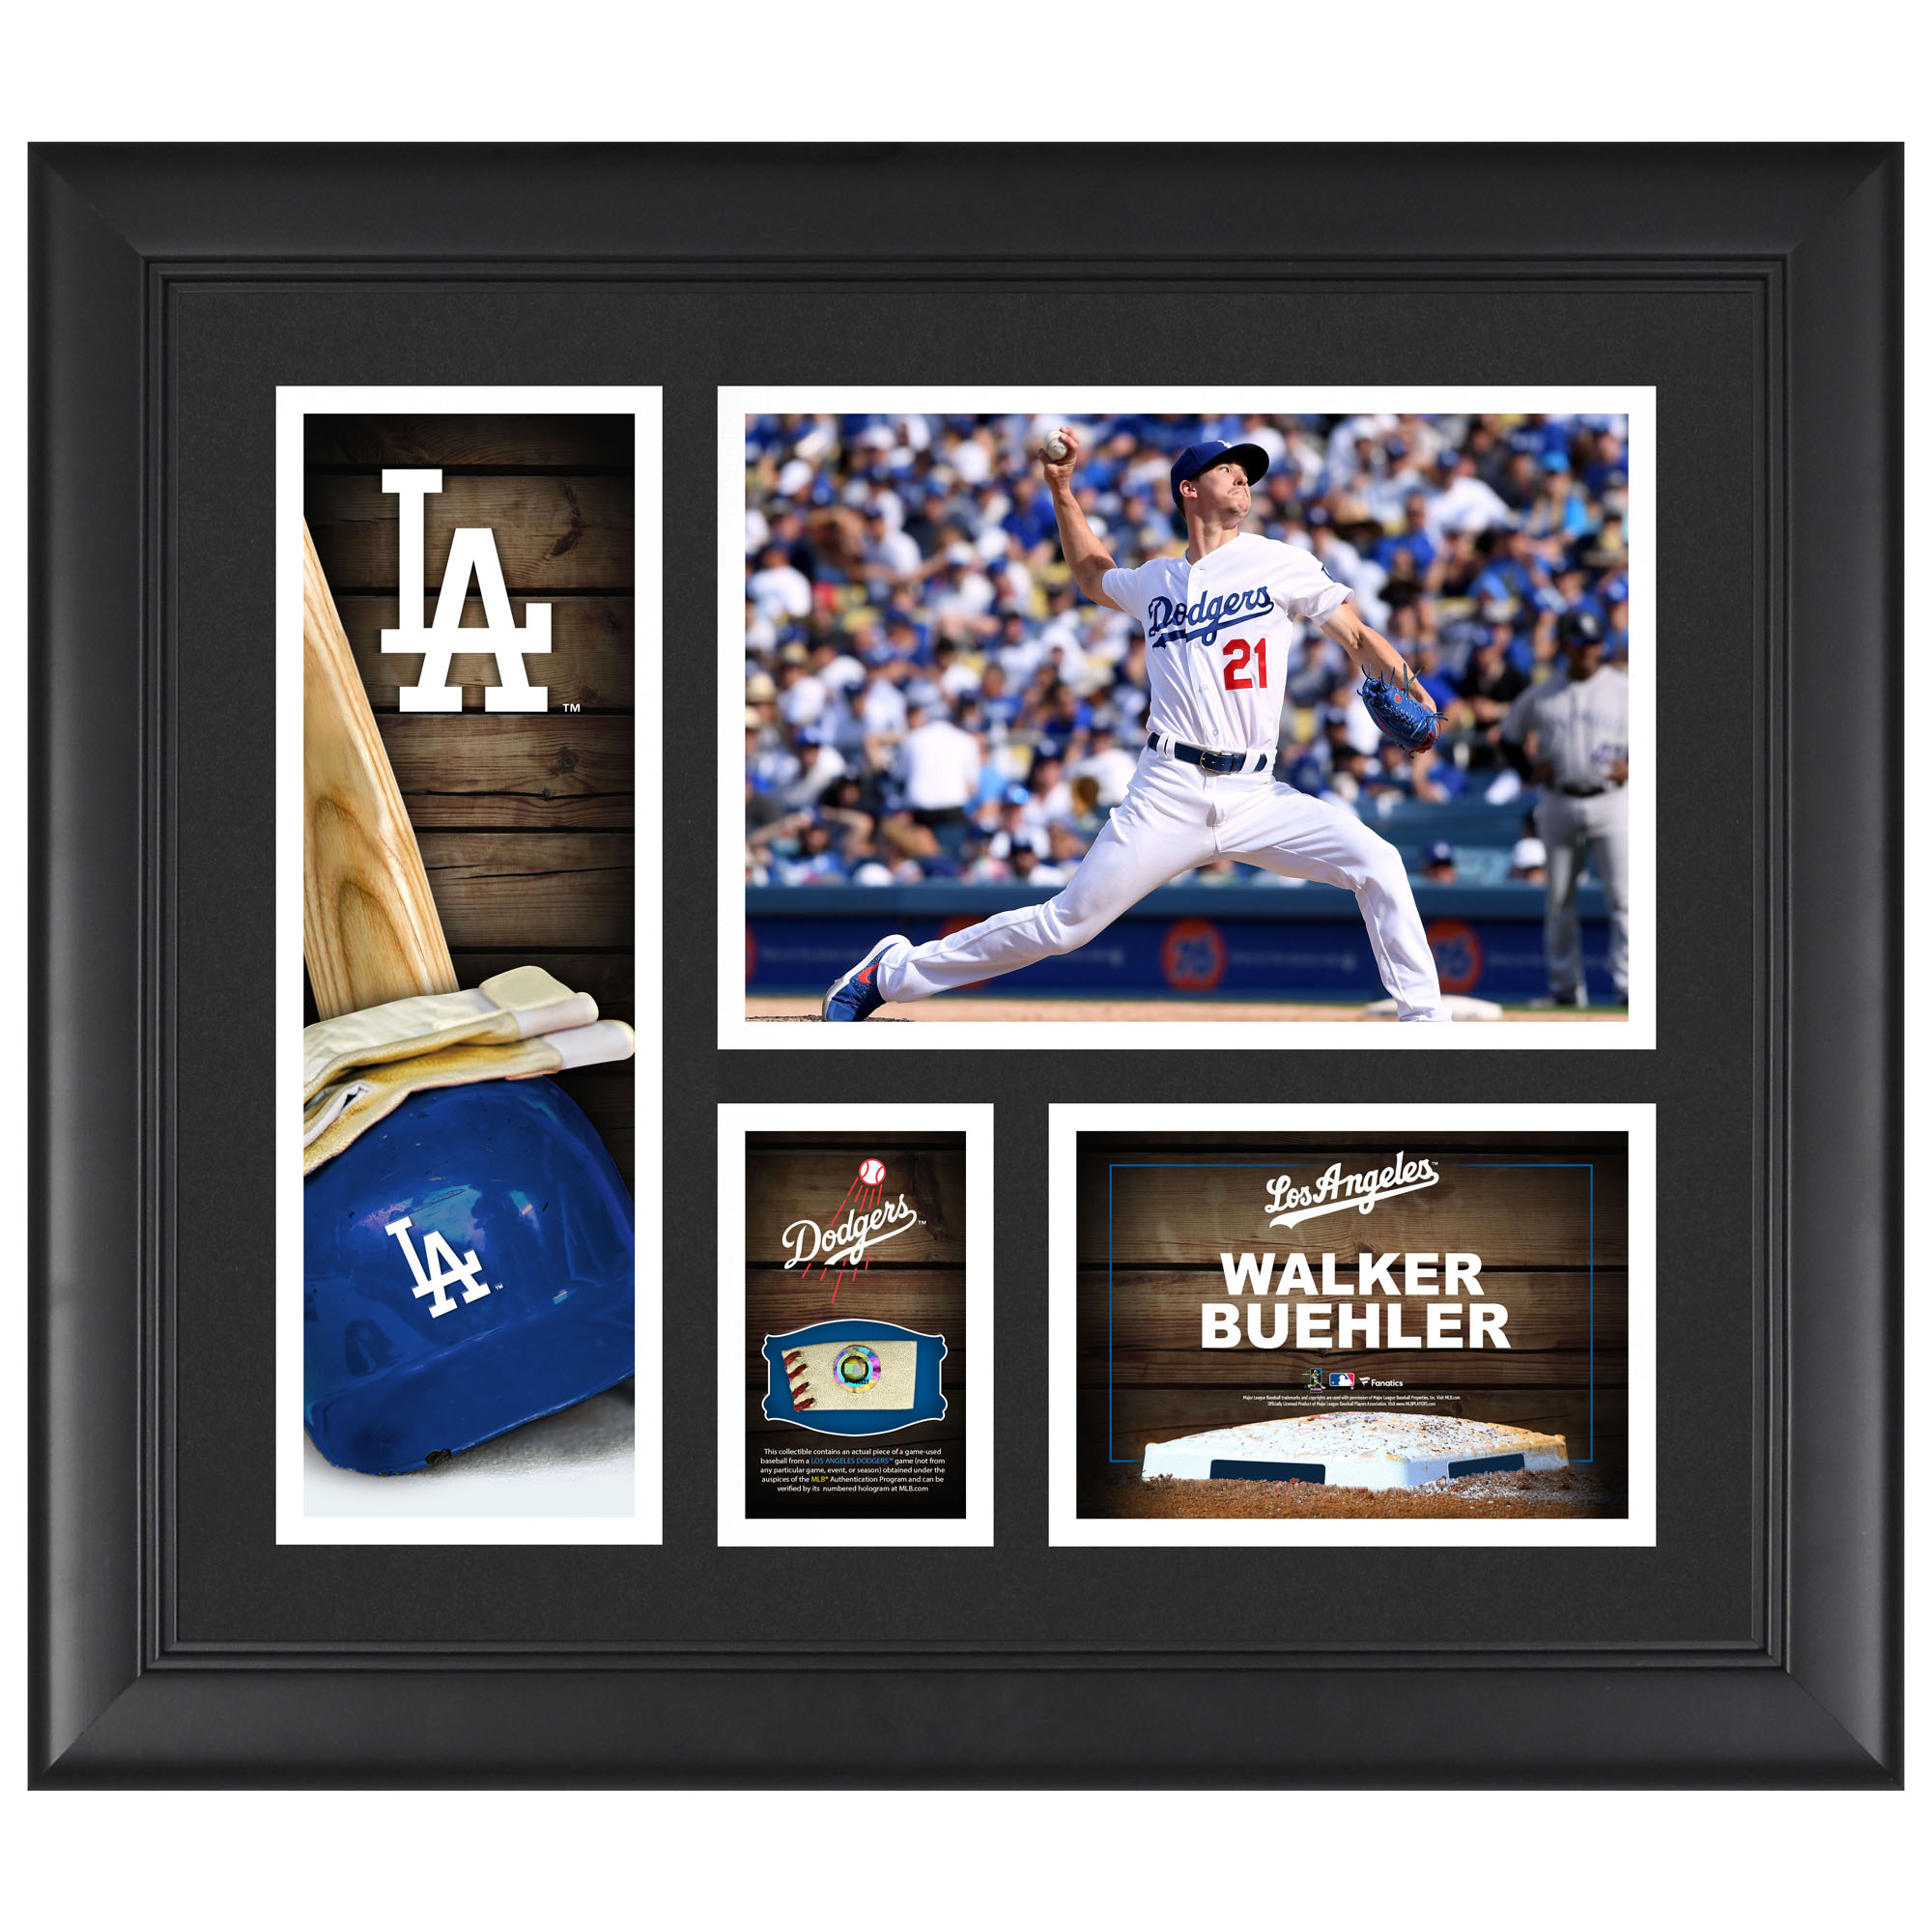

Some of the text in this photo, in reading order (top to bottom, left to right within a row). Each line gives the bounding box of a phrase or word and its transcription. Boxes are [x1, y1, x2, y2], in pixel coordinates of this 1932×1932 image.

[381, 469, 553, 713] LA
[1148, 585, 1275, 649] Dodgers
[1223, 638, 1268, 691] 21
[1264, 1175, 1313, 1213] Los
[1312, 1151, 1439, 1215] Angeles
[781, 1193, 918, 1270] Dodgers
[384, 1215, 492, 1319] LA
[1220, 1253, 1485, 1296] WALKER
[1201, 1302, 1511, 1349] BUEHLER
[1371, 1378, 1404, 1387] Fanatics
[873, 1448, 890, 1456] piece
[905, 1448, 941, 1456] game-used
[803, 1485, 811, 1493] by
[858, 1485, 890, 1493] hologram
